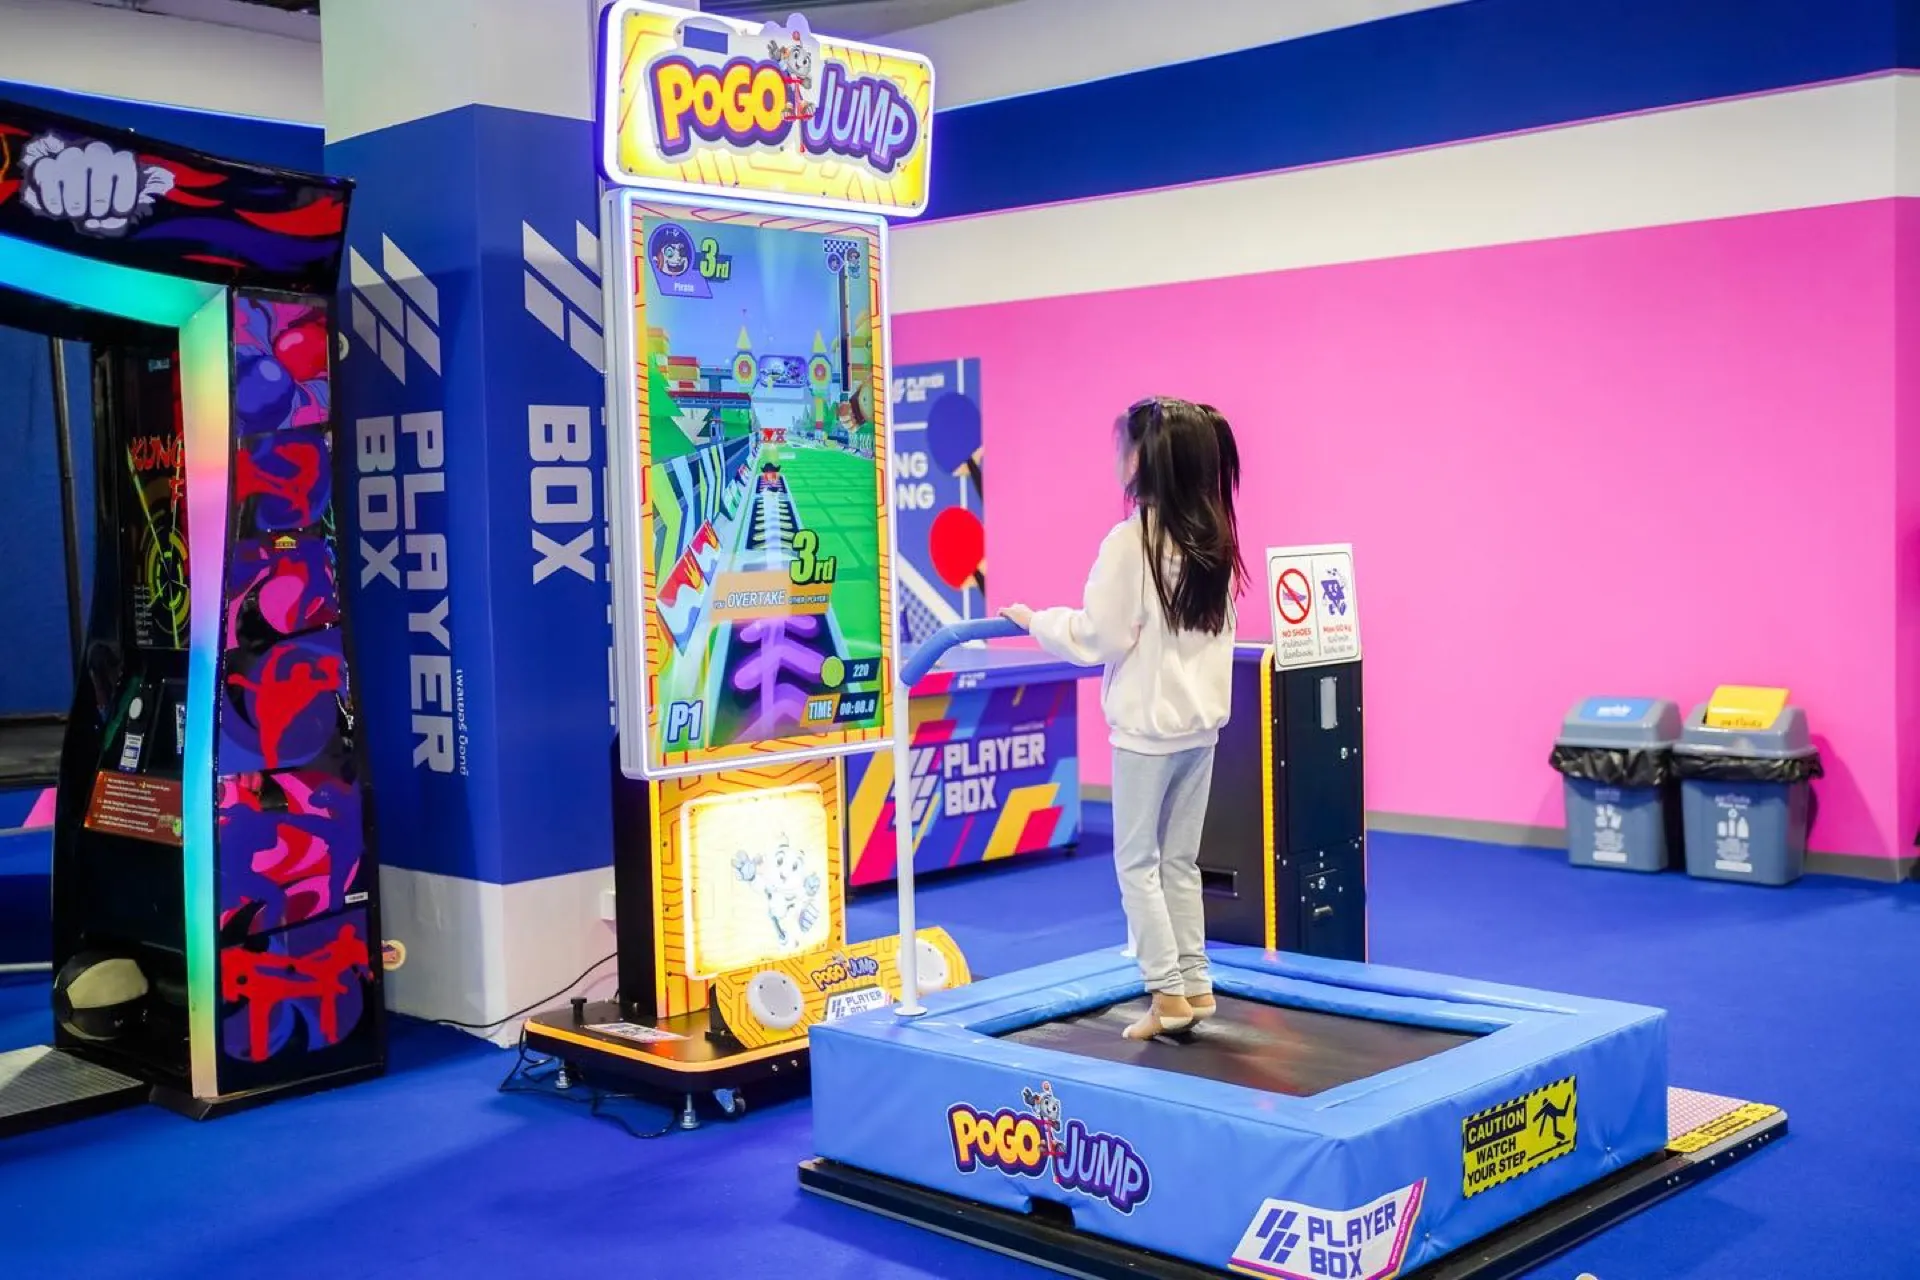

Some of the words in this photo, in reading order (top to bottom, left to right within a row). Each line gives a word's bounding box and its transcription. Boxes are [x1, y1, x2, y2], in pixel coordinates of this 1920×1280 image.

[653, 60, 789, 144] POGO
[805, 68, 912, 160] JUMP
[700, 238, 730, 279] 3rd
[894, 451, 929, 479] NG
[355, 415, 401, 590] BOX
[527, 404, 596, 586] BOX
[897, 482, 936, 510] NG
[790, 529, 836, 583] 3rd
[400, 410, 456, 774] PLAYER
[727, 589, 786, 609] OVERTAKE
[1292, 628, 1312, 637] SHOES
[852, 663, 870, 678] 220
[667, 700, 704, 744] P1
[808, 700, 833, 720] TIME
[943, 732, 1046, 780] PLAYER
[944, 775, 997, 818] BOX
[811, 963, 847, 992] POGO
[849, 957, 879, 978] JUMP
[846, 991, 882, 1006] PLAYER
[1468, 1107, 1525, 1145] CAUTION
[951, 1108, 1042, 1168] POGO
[1057, 1124, 1145, 1204] JUMP
[1467, 1162, 1497, 1187] YOUR
[1498, 1150, 1526, 1173] STEP
[1476, 1136, 1517, 1165] WATCH
[1307, 1200, 1397, 1249] PLAYER
[1309, 1247, 1363, 1279] BOX
